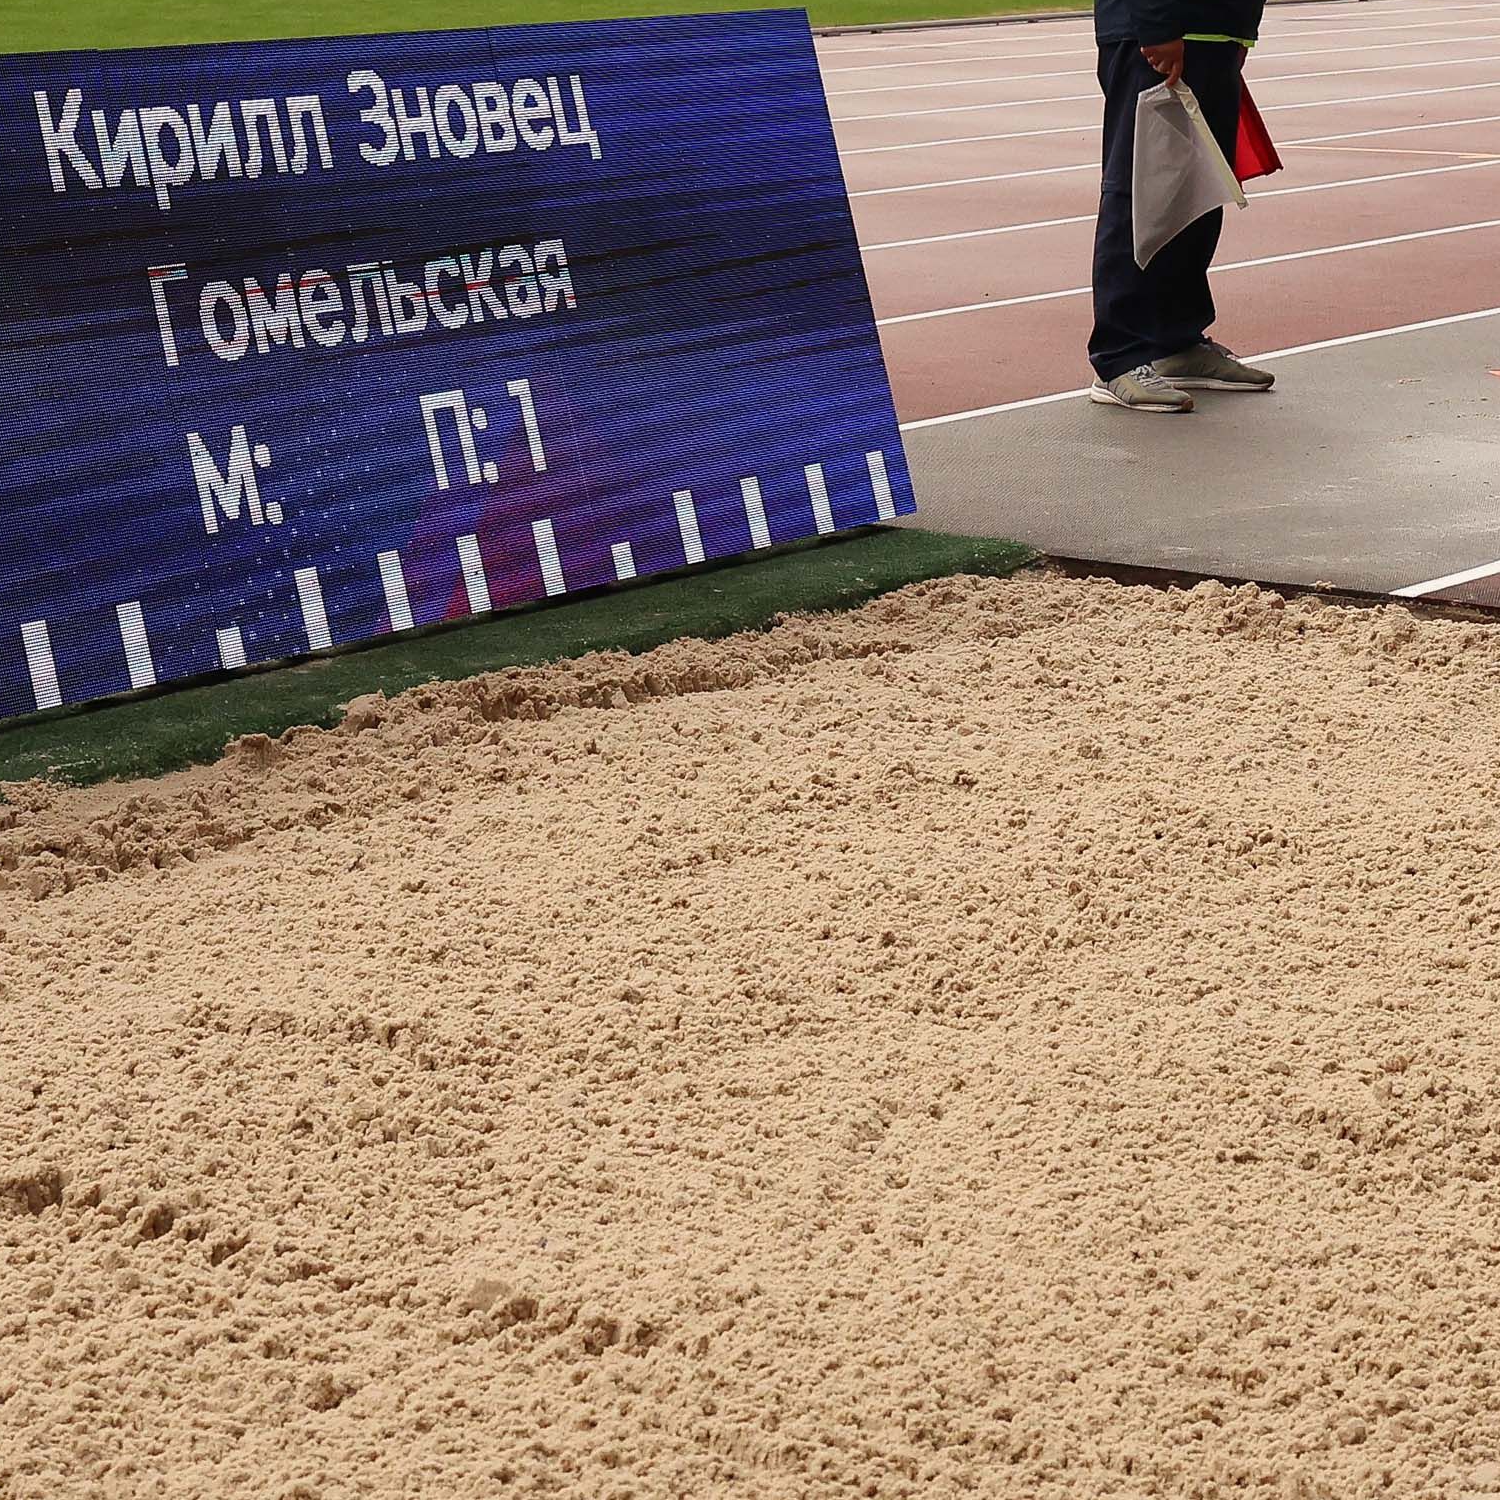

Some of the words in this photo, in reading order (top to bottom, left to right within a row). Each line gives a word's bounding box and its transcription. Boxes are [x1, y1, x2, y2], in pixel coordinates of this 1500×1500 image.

[32, 85, 335, 210] Кирилл
[346, 70, 603, 168] Зновец
[146, 238, 578, 367] Гомельская
[185, 423, 283, 535] М:
